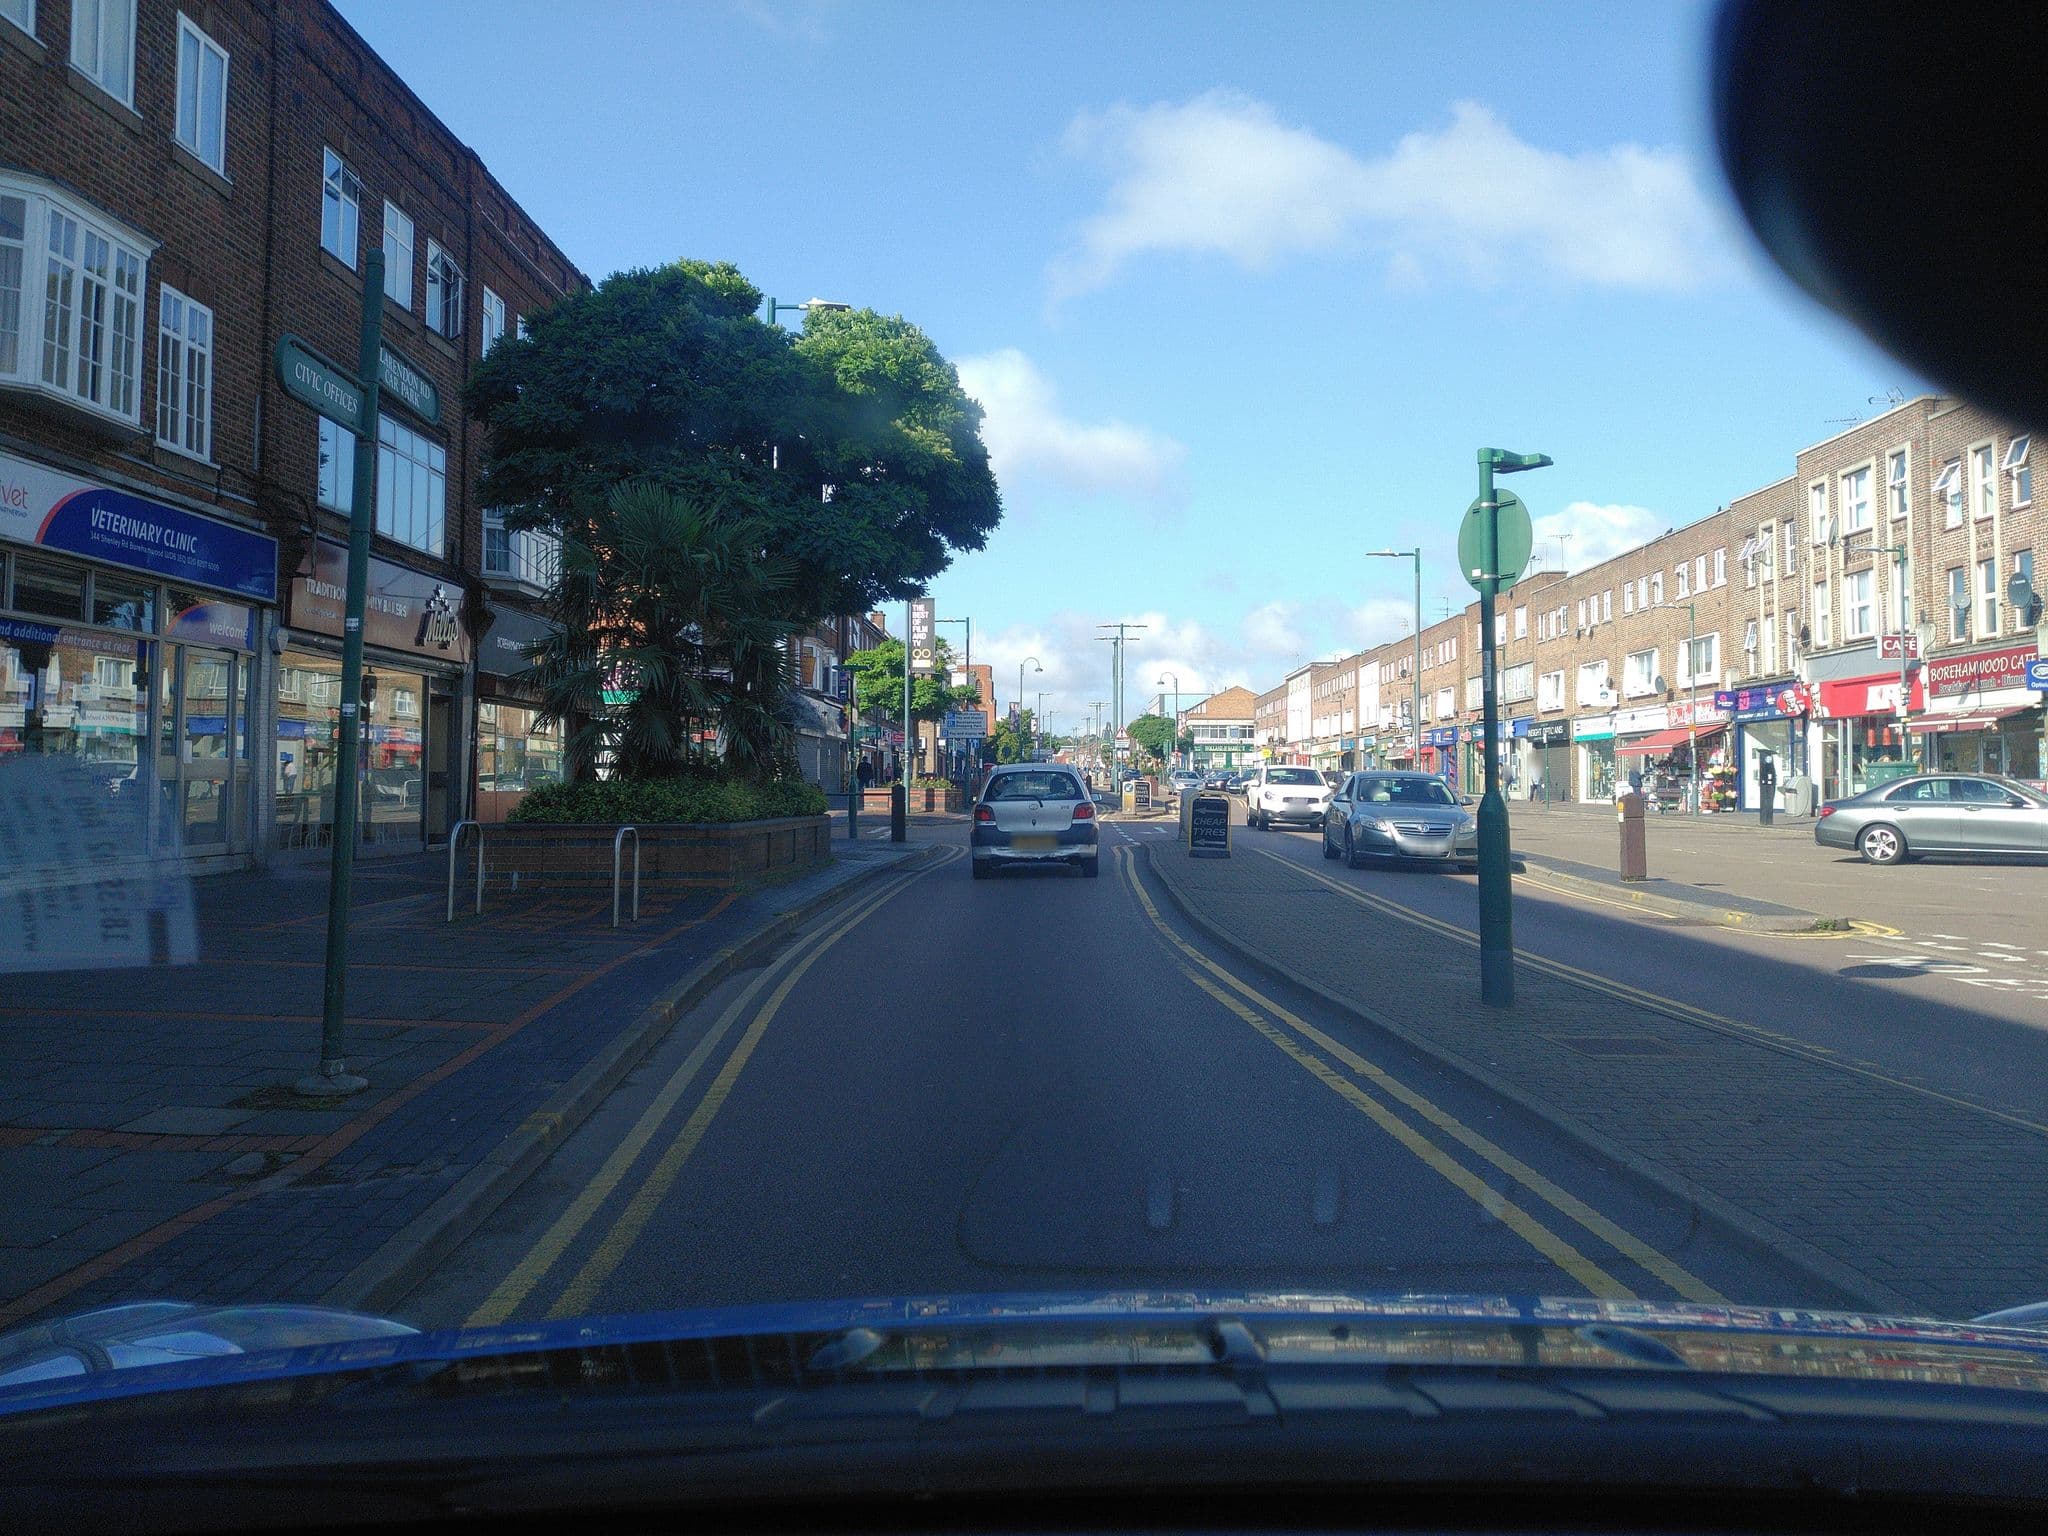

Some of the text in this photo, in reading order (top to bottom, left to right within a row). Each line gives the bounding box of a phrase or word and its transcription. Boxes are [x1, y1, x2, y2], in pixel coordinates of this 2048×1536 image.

[379, 346, 431, 400] LARENDON RD
[295, 361, 359, 414] CIVIC OFFICES
[384, 367, 421, 408] CAR PARK
[0, 480, 28, 509] Vet
[91, 506, 198, 554] VETERINARY CLINIC
[305, 577, 347, 602] TRADITION
[912, 611, 929, 619] BEST
[912, 618, 921, 626] OF
[13, 624, 61, 643] additional
[63, 633, 101, 649] entrance
[103, 640, 112, 650] at
[209, 622, 248, 641] welcome
[912, 625, 928, 633] FILM
[1883, 638, 1917, 651] CAFÉ
[1930, 656, 2009, 681] BOREHAMWOOD
[1193, 817, 1226, 826] CHEAP
[1193, 827, 1226, 837] TYRES
